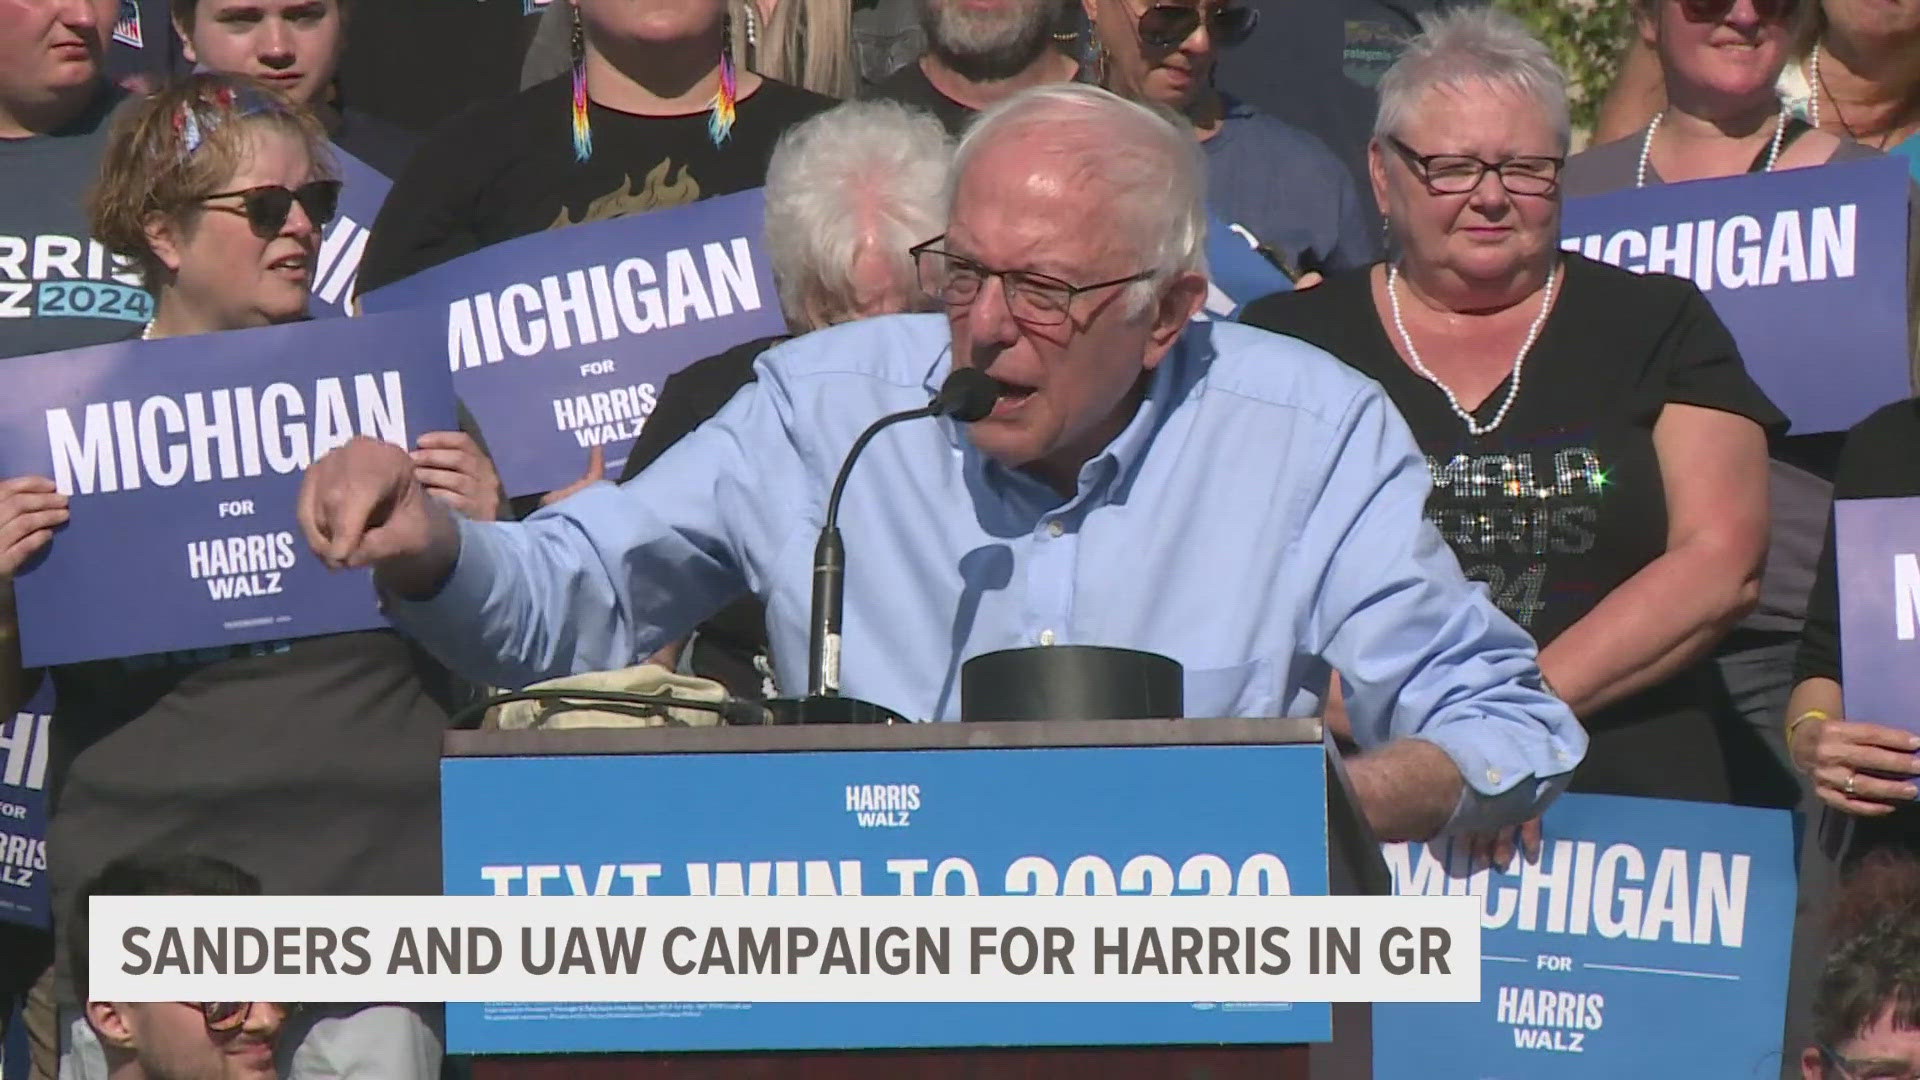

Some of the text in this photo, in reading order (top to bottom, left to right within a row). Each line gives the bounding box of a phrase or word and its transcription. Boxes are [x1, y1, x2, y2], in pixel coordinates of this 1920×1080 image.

[1560, 204, 1856, 291] CHIGAN
[42, 285, 148, 317] 2024
[580, 360, 615, 378] FOR
[553, 383, 657, 431] HARRIS
[46, 371, 407, 495] MICHIGAN
[574, 417, 647, 448] WALZ
[219, 500, 254, 518] FOR
[187, 532, 295, 578] HARRIS
[207, 572, 282, 600] WALZ
[846, 784, 920, 811] HARRIS
[857, 812, 909, 827] WALZ
[1537, 954, 1571, 972] FOR
[1497, 986, 1604, 1030] HARRIS
[1514, 1027, 1584, 1053] WALZ
